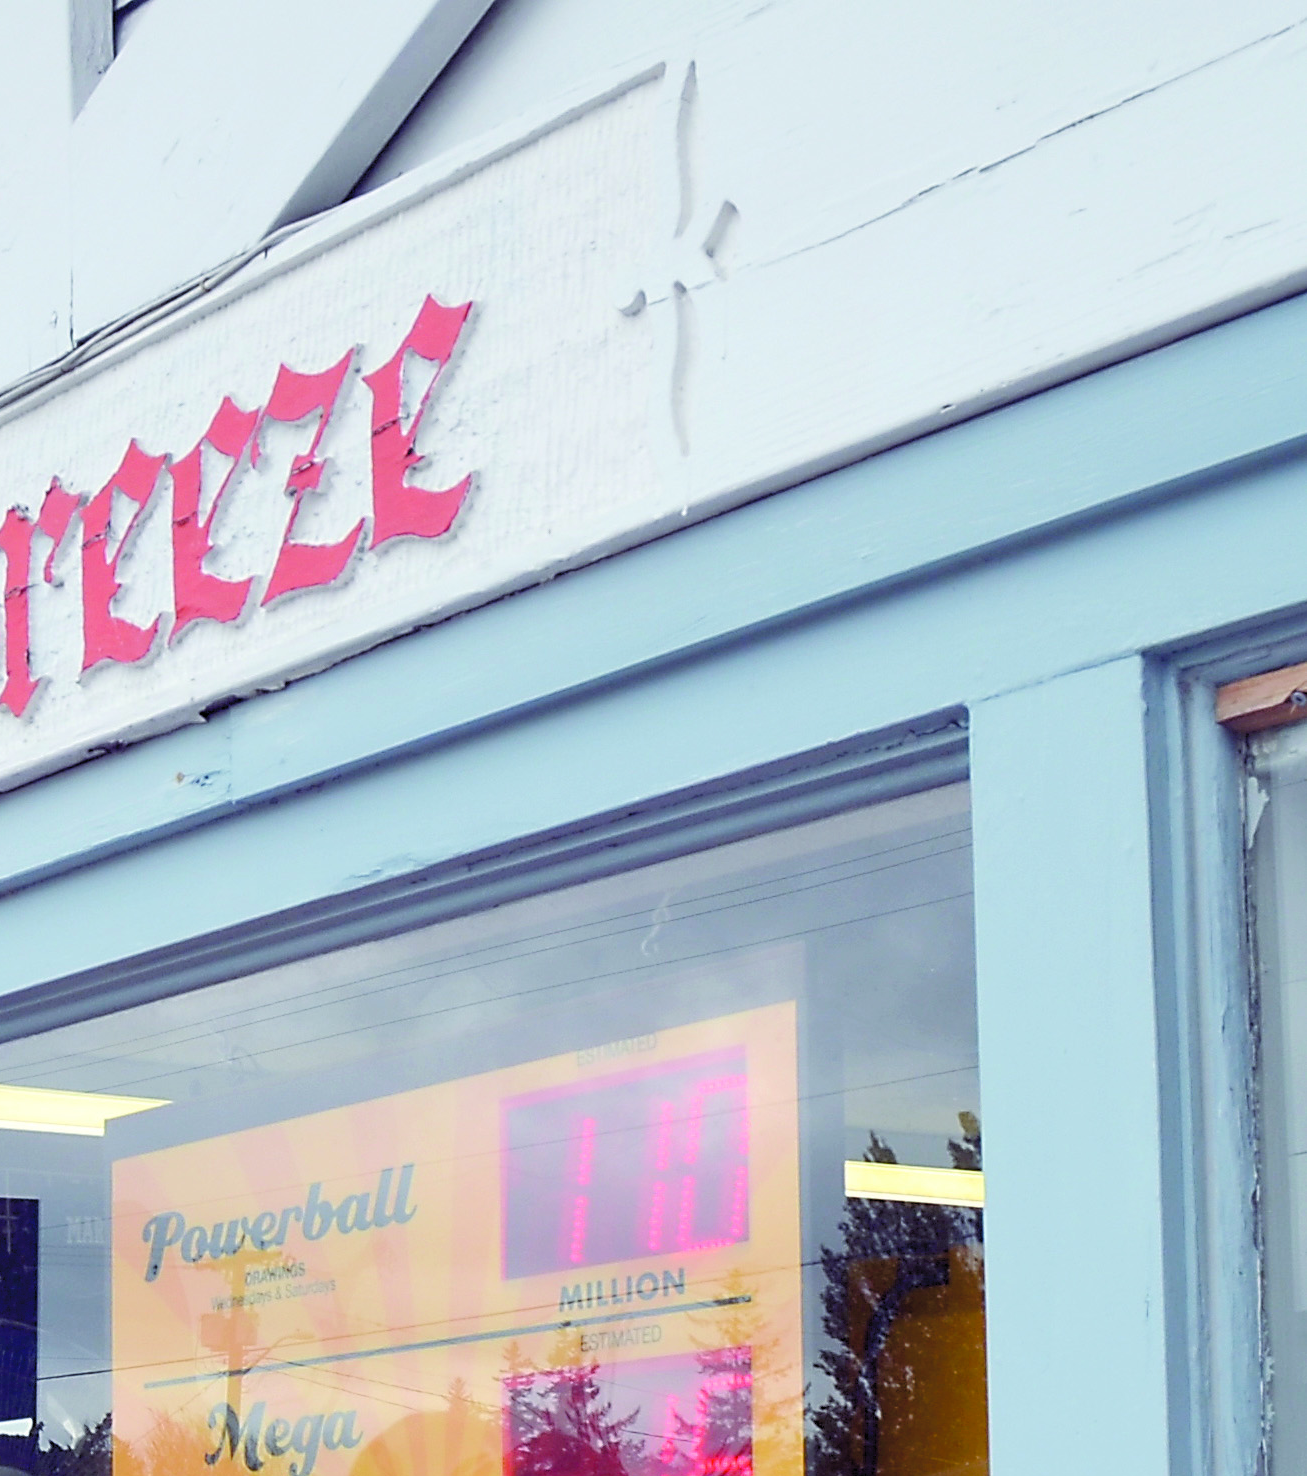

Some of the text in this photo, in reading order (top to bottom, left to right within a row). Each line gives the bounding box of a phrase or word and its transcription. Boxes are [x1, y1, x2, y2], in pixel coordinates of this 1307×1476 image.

[576, 1034, 658, 1066] ESTIMATED
[142, 1163, 417, 1282] Powerball
[245, 1262, 305, 1286] DRAWINGS
[274, 1287, 283, 1300] &
[285, 1279, 336, 1299] Saturdays
[559, 1267, 685, 1312] MILLION
[580, 1325, 662, 1352] ESTIMATED
